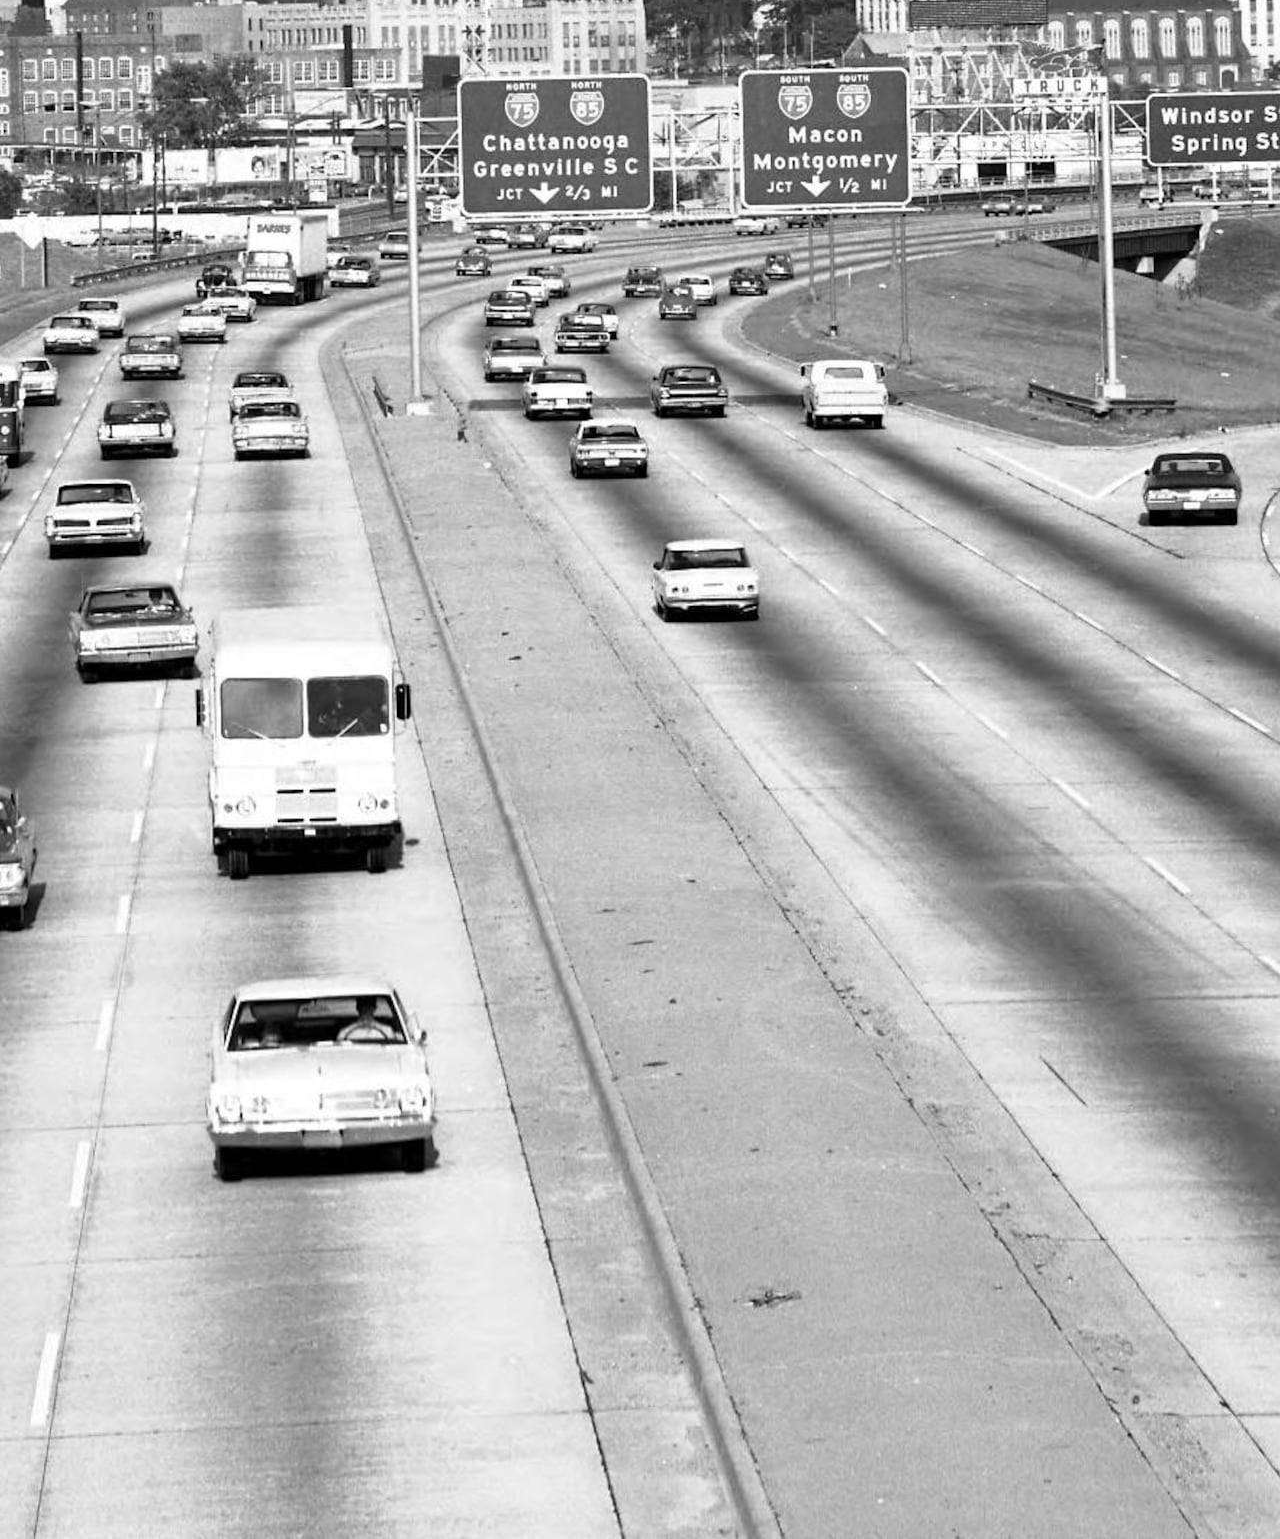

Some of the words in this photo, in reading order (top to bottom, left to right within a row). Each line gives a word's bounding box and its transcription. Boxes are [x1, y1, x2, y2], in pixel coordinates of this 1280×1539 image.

[506, 82, 537, 91] NORTH
[571, 81, 602, 89] NORTH
[780, 75, 811, 83] SOUTH
[839, 74, 869, 83] SOUTH
[1024, 79, 1099, 93] TRUCK
[576, 101, 600, 118] 85
[784, 96, 808, 112] 75
[843, 94, 866, 111] 85
[510, 103, 534, 120] 75
[1161, 107, 1254, 125] Windsor
[788, 126, 863, 144] Macon
[483, 133, 629, 155] Chattanooga
[1171, 133, 1248, 157] Spring
[1255, 132, 1280, 150] St
[473, 158, 595, 178] Greenville
[604, 158, 618, 175] S
[625, 157, 638, 175] C
[753, 152, 898, 174] Montgomery
[496, 188, 523, 201] JCT
[565, 184, 591, 201] 2/3
[601, 185, 618, 198] MI
[766, 181, 793, 193] JCT
[839, 177, 861, 194] 1/2
[871, 178, 887, 191] MI
